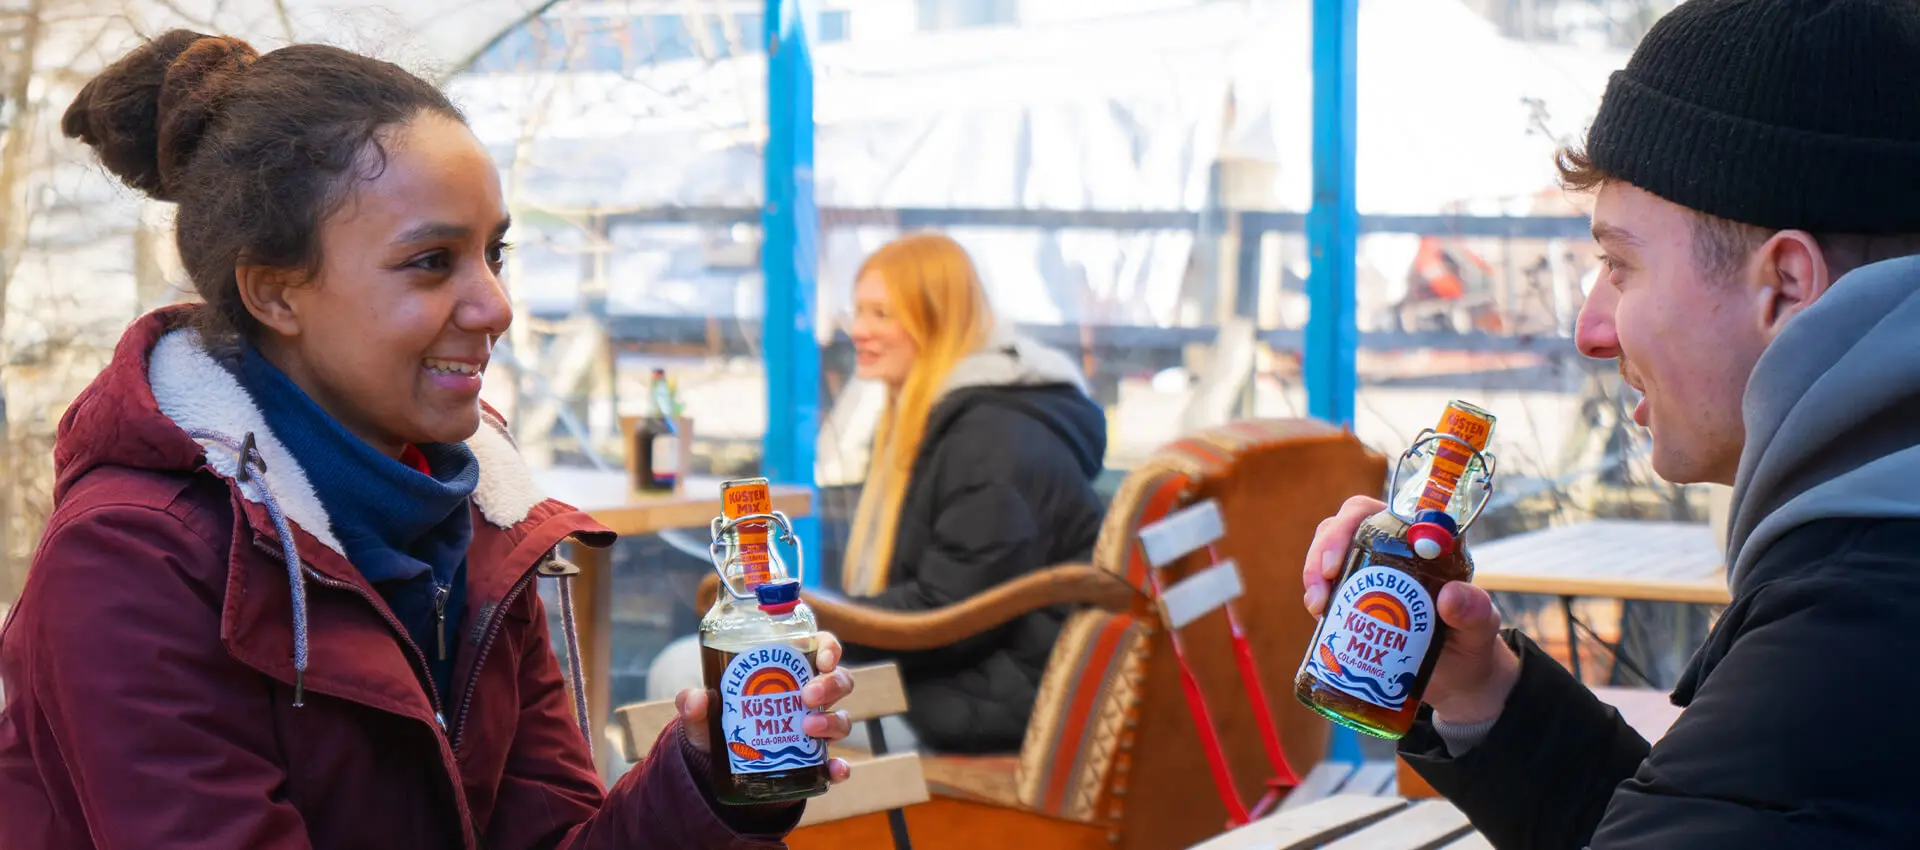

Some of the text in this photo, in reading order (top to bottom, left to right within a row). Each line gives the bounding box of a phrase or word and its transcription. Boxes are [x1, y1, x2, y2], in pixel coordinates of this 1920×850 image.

[1446, 412, 1485, 436] KÜSTEN
[737, 503, 760, 514] MIX
[1343, 572, 1428, 633] FLENSBURGER
[1343, 611, 1408, 653] KÜSTEN
[1346, 636, 1389, 666] MIX
[1337, 652, 1386, 679] COLA-ORANGE
[740, 695, 803, 720] KÜSTEN
[755, 716, 794, 736] MIX
[751, 734, 800, 747] COLA-ORANGE
